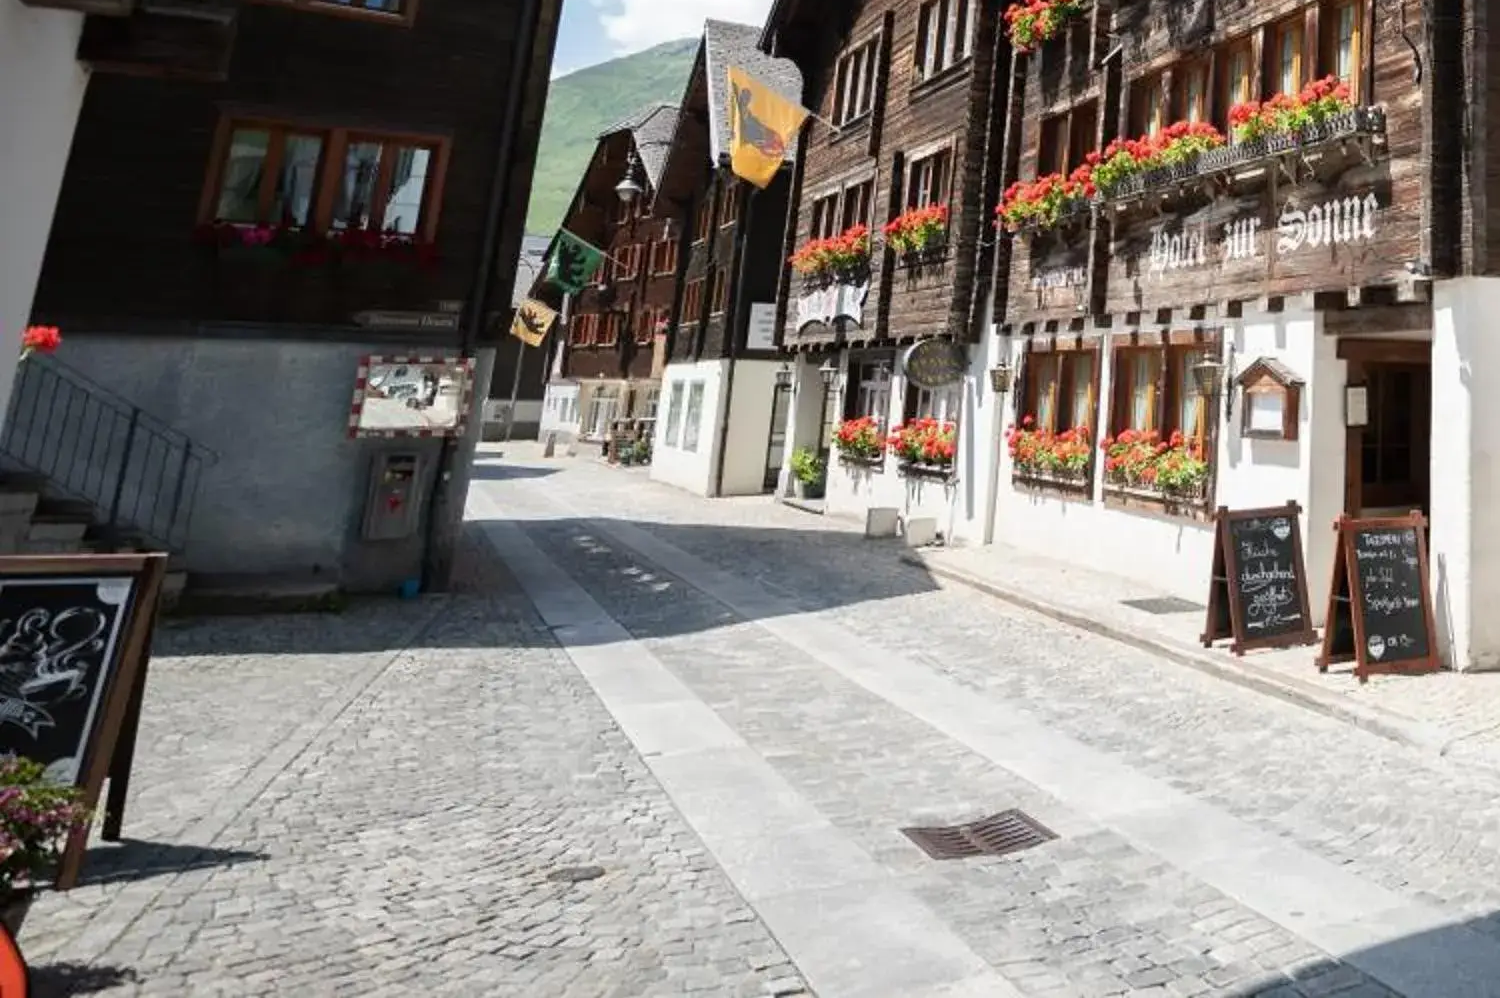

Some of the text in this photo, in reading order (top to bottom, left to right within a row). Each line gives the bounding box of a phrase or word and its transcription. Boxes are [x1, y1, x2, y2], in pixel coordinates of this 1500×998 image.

[1150, 192, 1378, 276] Hotel zur Sonne
